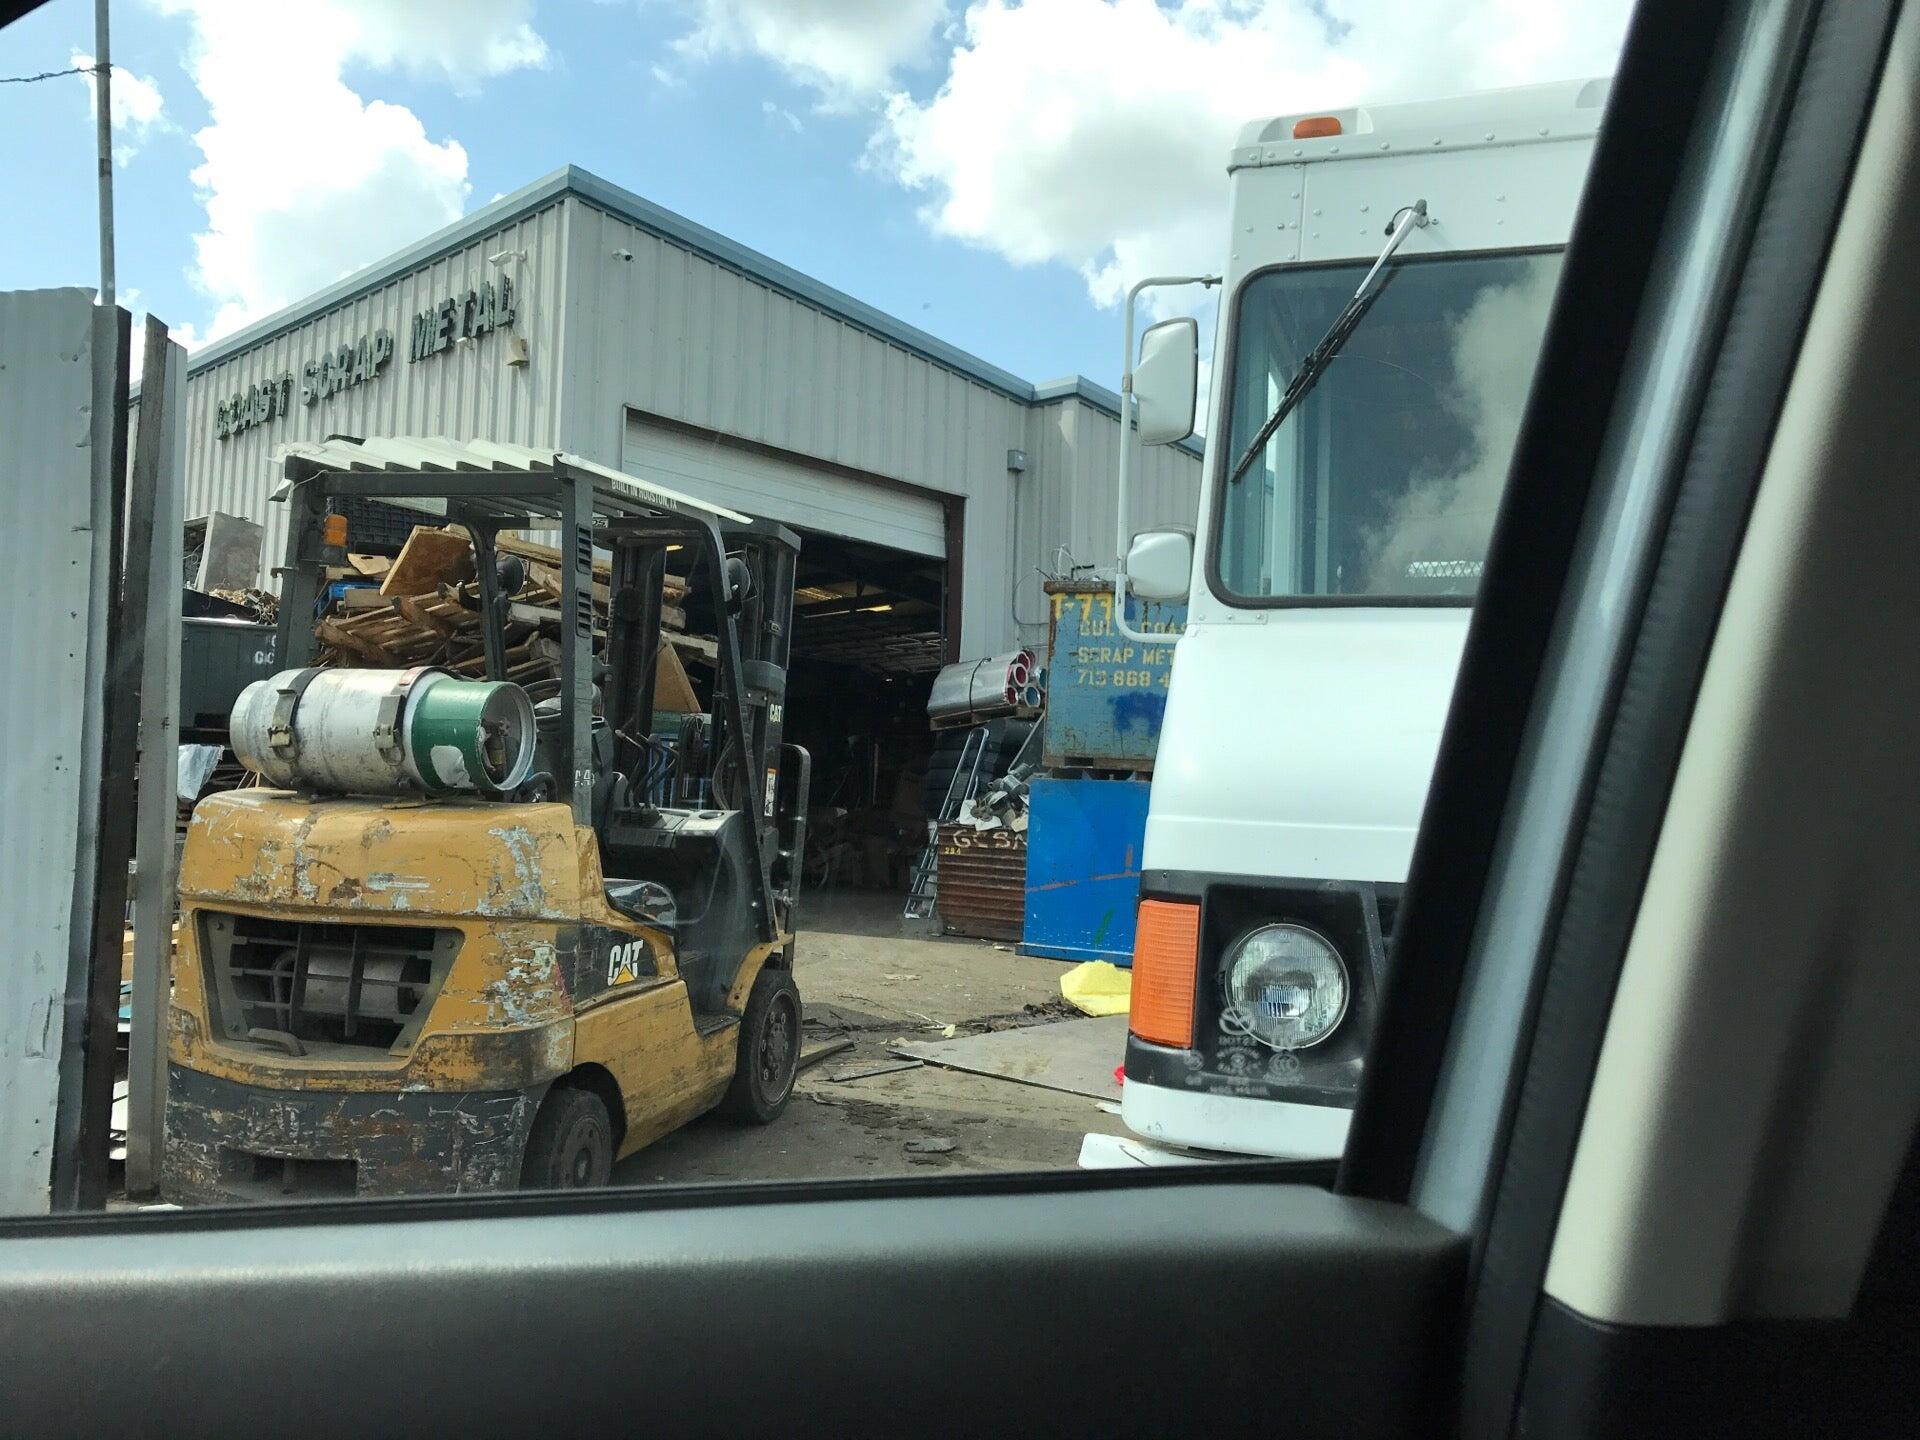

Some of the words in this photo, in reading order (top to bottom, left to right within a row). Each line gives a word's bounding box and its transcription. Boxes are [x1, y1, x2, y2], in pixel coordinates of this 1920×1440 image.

[216, 370, 293, 440] COAST
[300, 328, 393, 406] SCRAP
[408, 274, 515, 364] METAL
[769, 703, 782, 723] CAT
[607, 939, 644, 986] CAT
